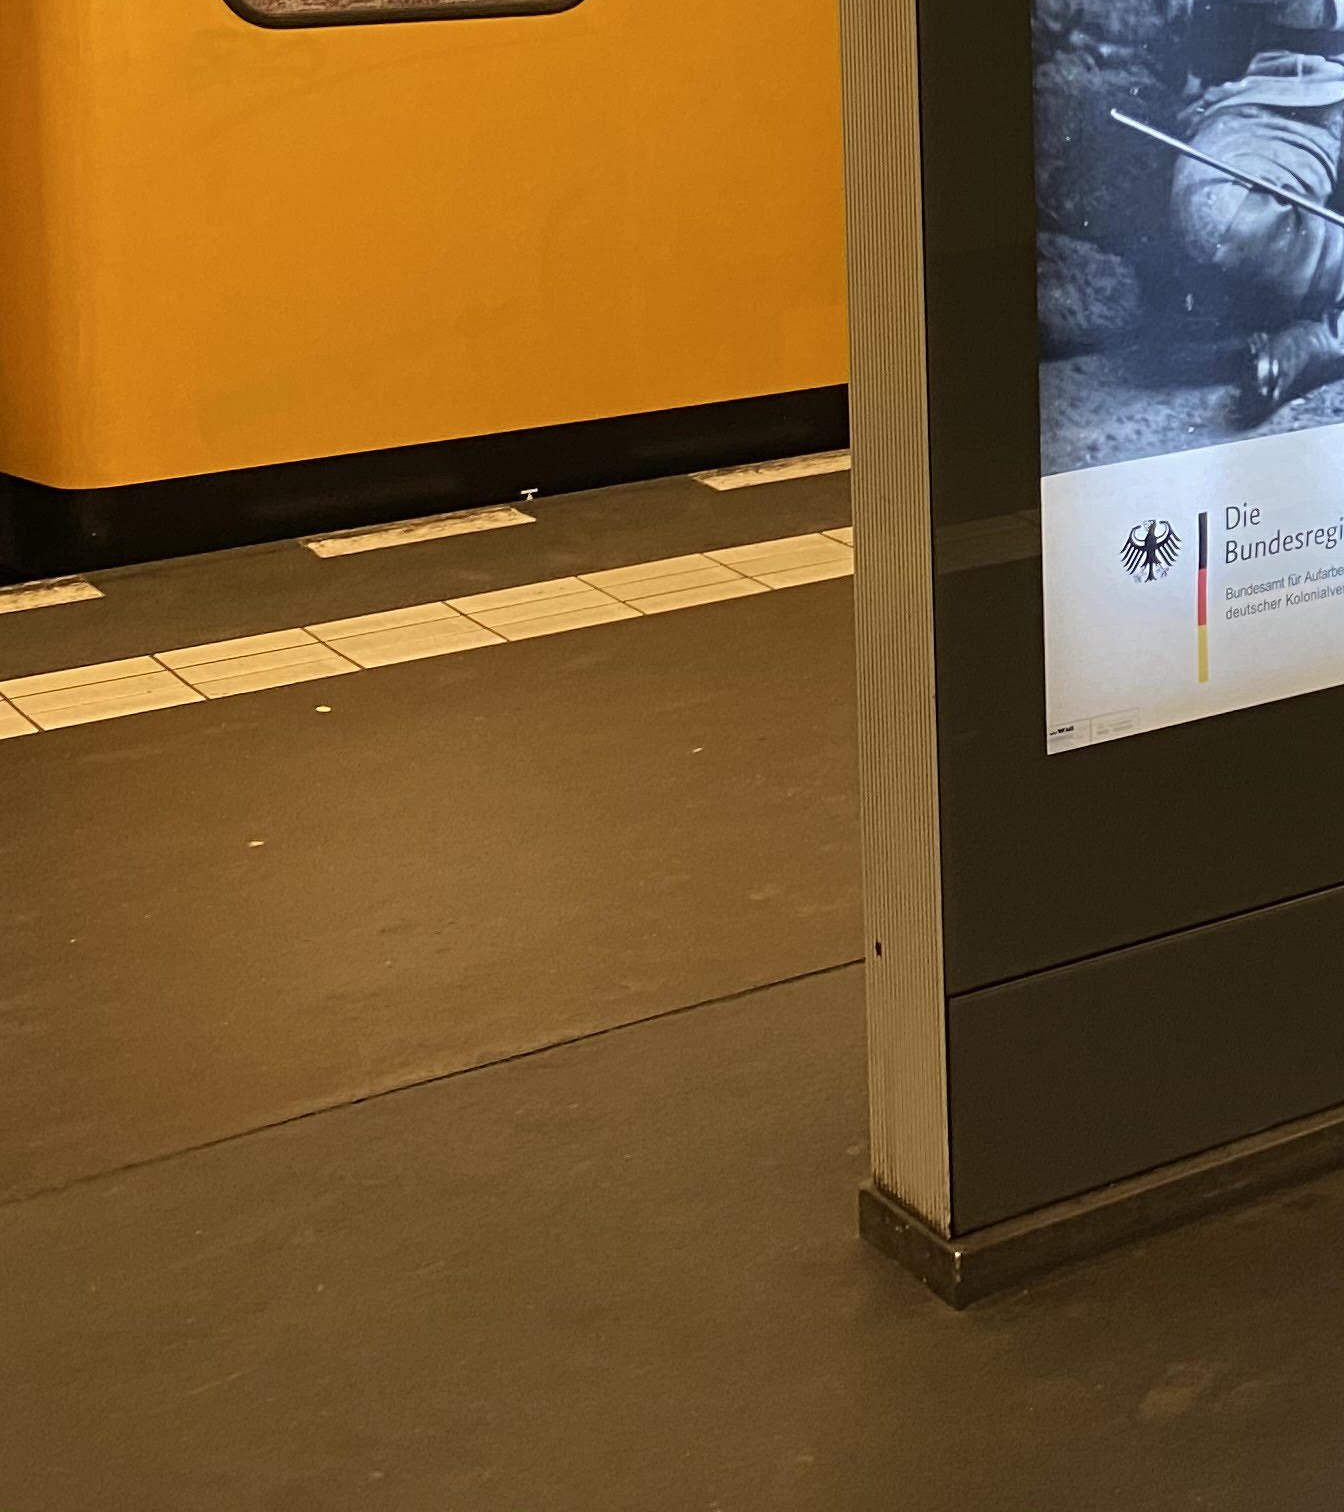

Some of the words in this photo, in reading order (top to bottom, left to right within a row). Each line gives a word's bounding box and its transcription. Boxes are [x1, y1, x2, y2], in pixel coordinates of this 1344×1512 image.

[1225, 501, 1261, 531] Die
[1225, 576, 1285, 601] Bundesamt
[1287, 573, 1301, 587] für
[1225, 596, 1283, 620] deutscher
